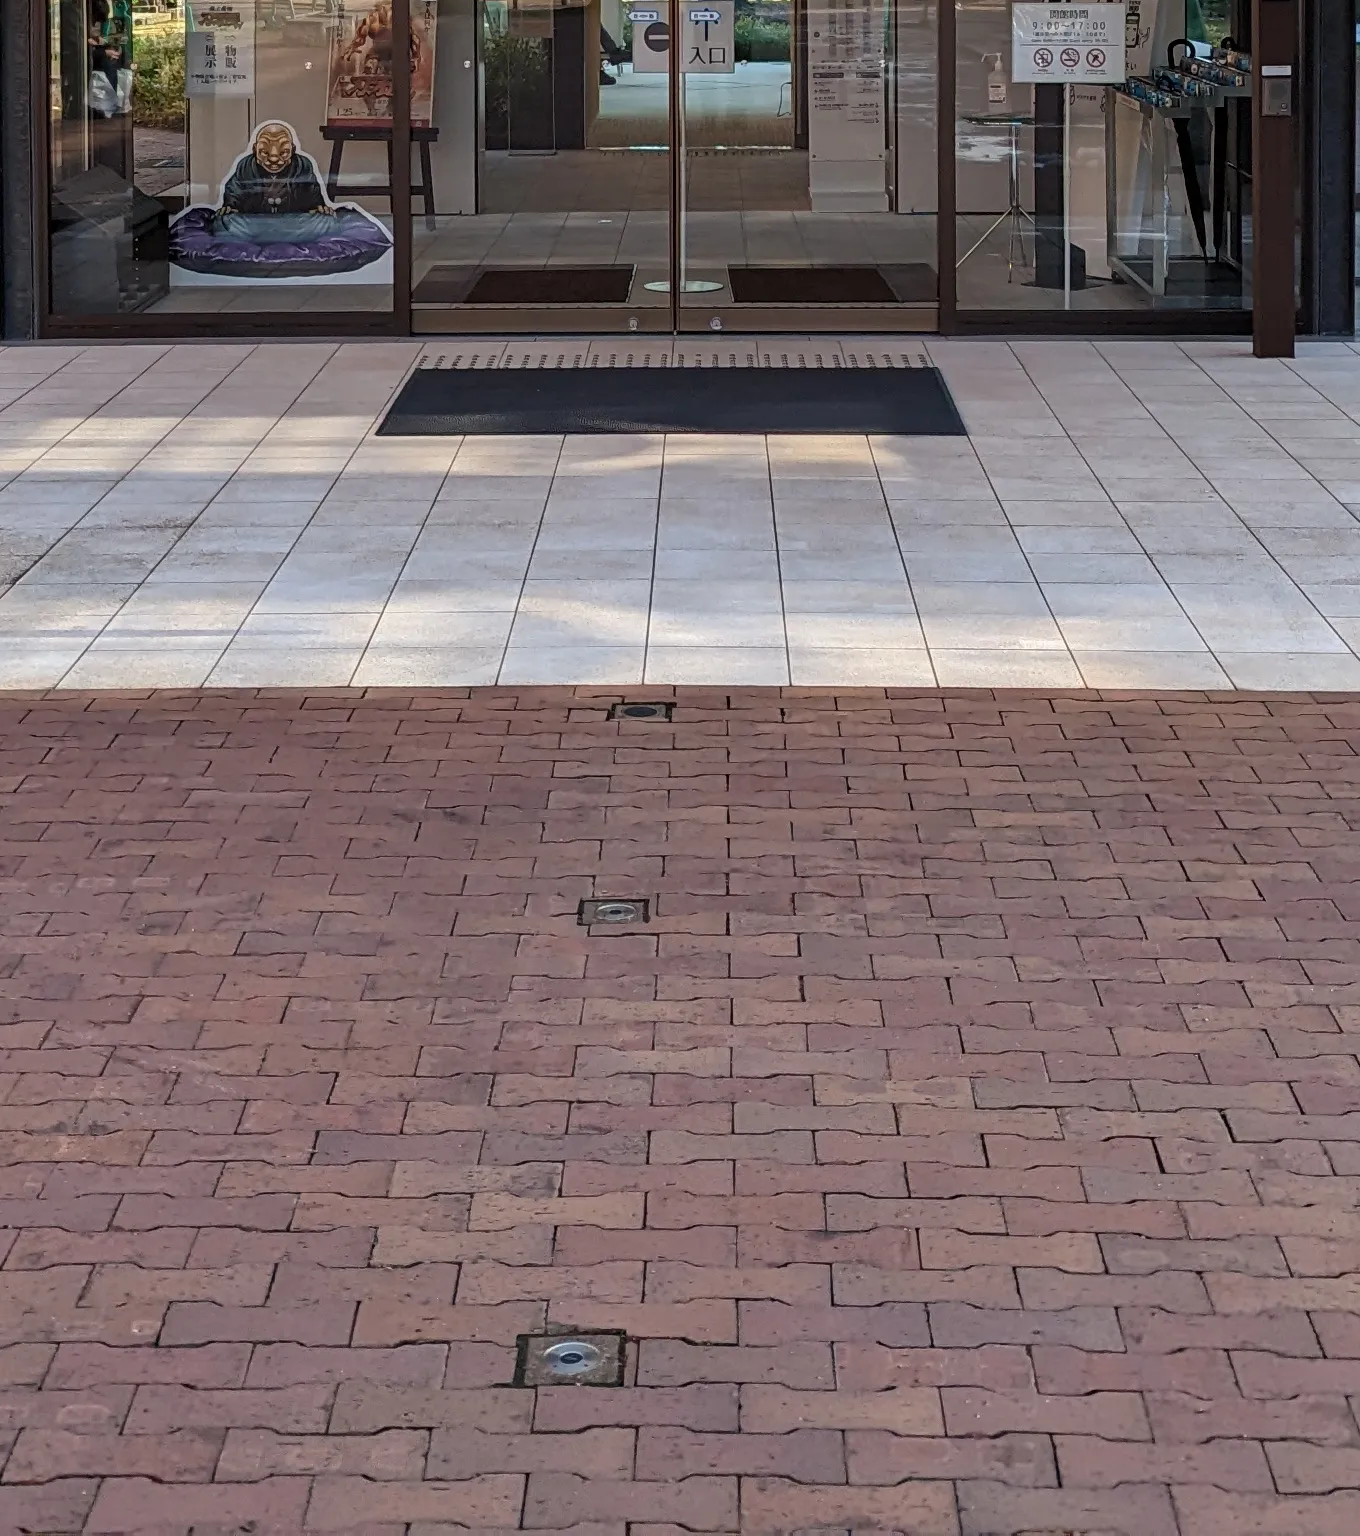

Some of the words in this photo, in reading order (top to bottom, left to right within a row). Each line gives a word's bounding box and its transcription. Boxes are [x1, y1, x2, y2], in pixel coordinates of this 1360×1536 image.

[205, 45, 217, 68] 展示
[225, 45, 237, 68] 物販
[689, 46, 726, 64] 入口
